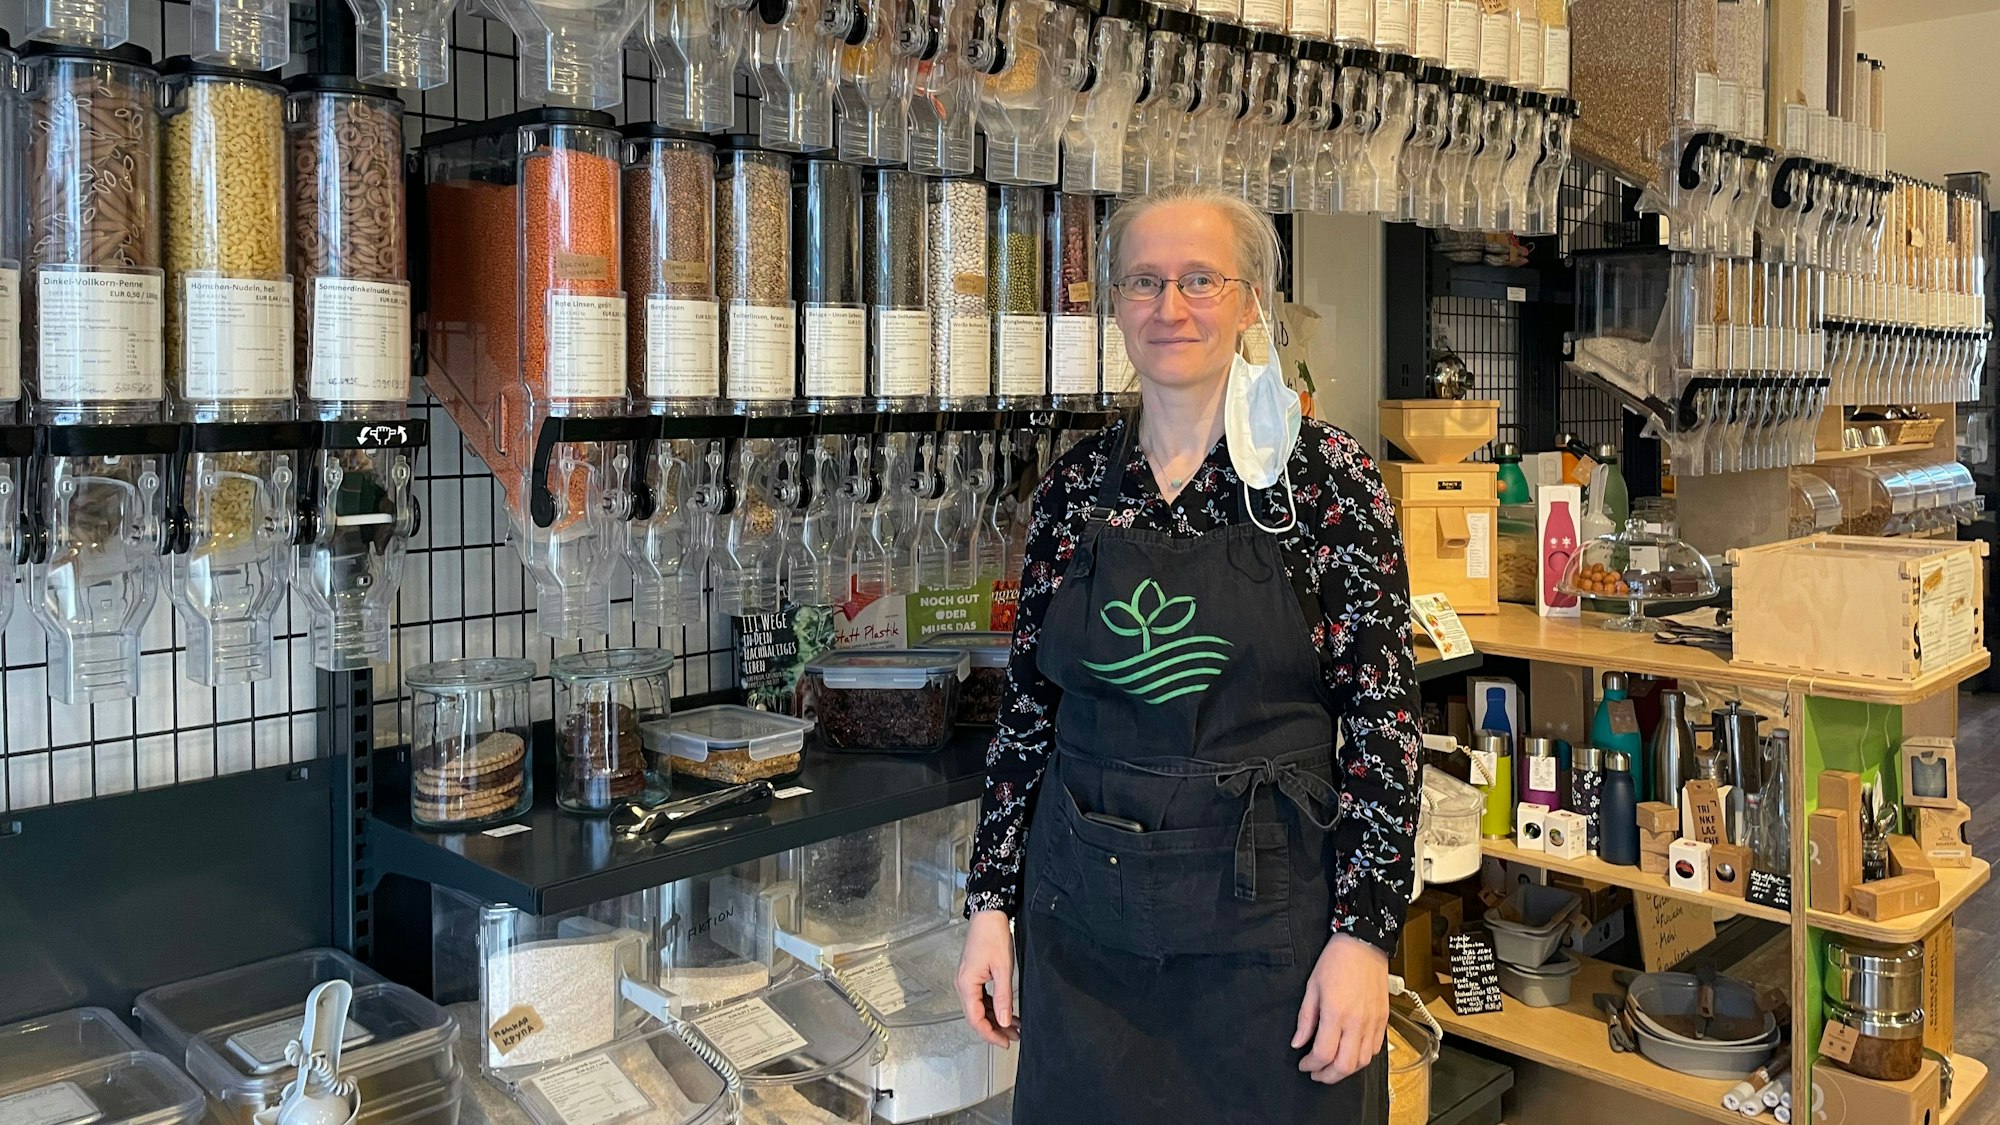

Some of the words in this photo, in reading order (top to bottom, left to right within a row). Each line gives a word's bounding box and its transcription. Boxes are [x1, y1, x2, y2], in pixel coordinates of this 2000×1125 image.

[43, 277, 144, 289] Dinkel-Vollkorn-Penne
[191, 282, 263, 293] Hörnchen-Nudeln,
[319, 283, 391, 296] Sommerdinkelnudel,
[126, 291, 141, 299] 0,50
[572, 301, 597, 309] Linsen,
[920, 595, 954, 607] NOCH
[957, 594, 980, 605] GUT
[761, 613, 788, 631] WEGE
[955, 620, 977, 632] DAS
[864, 623, 899, 641] Plastik
[754, 632, 773, 646] DEIN
[744, 642, 797, 660] NACHHALTIGES
[745, 660, 766, 675] LEBEN
[1697, 805, 1710, 814] TRI
[1701, 826, 1716, 835] LAS
[687, 905, 736, 942] AKTION
[502, 1025, 535, 1047] КРУПА
